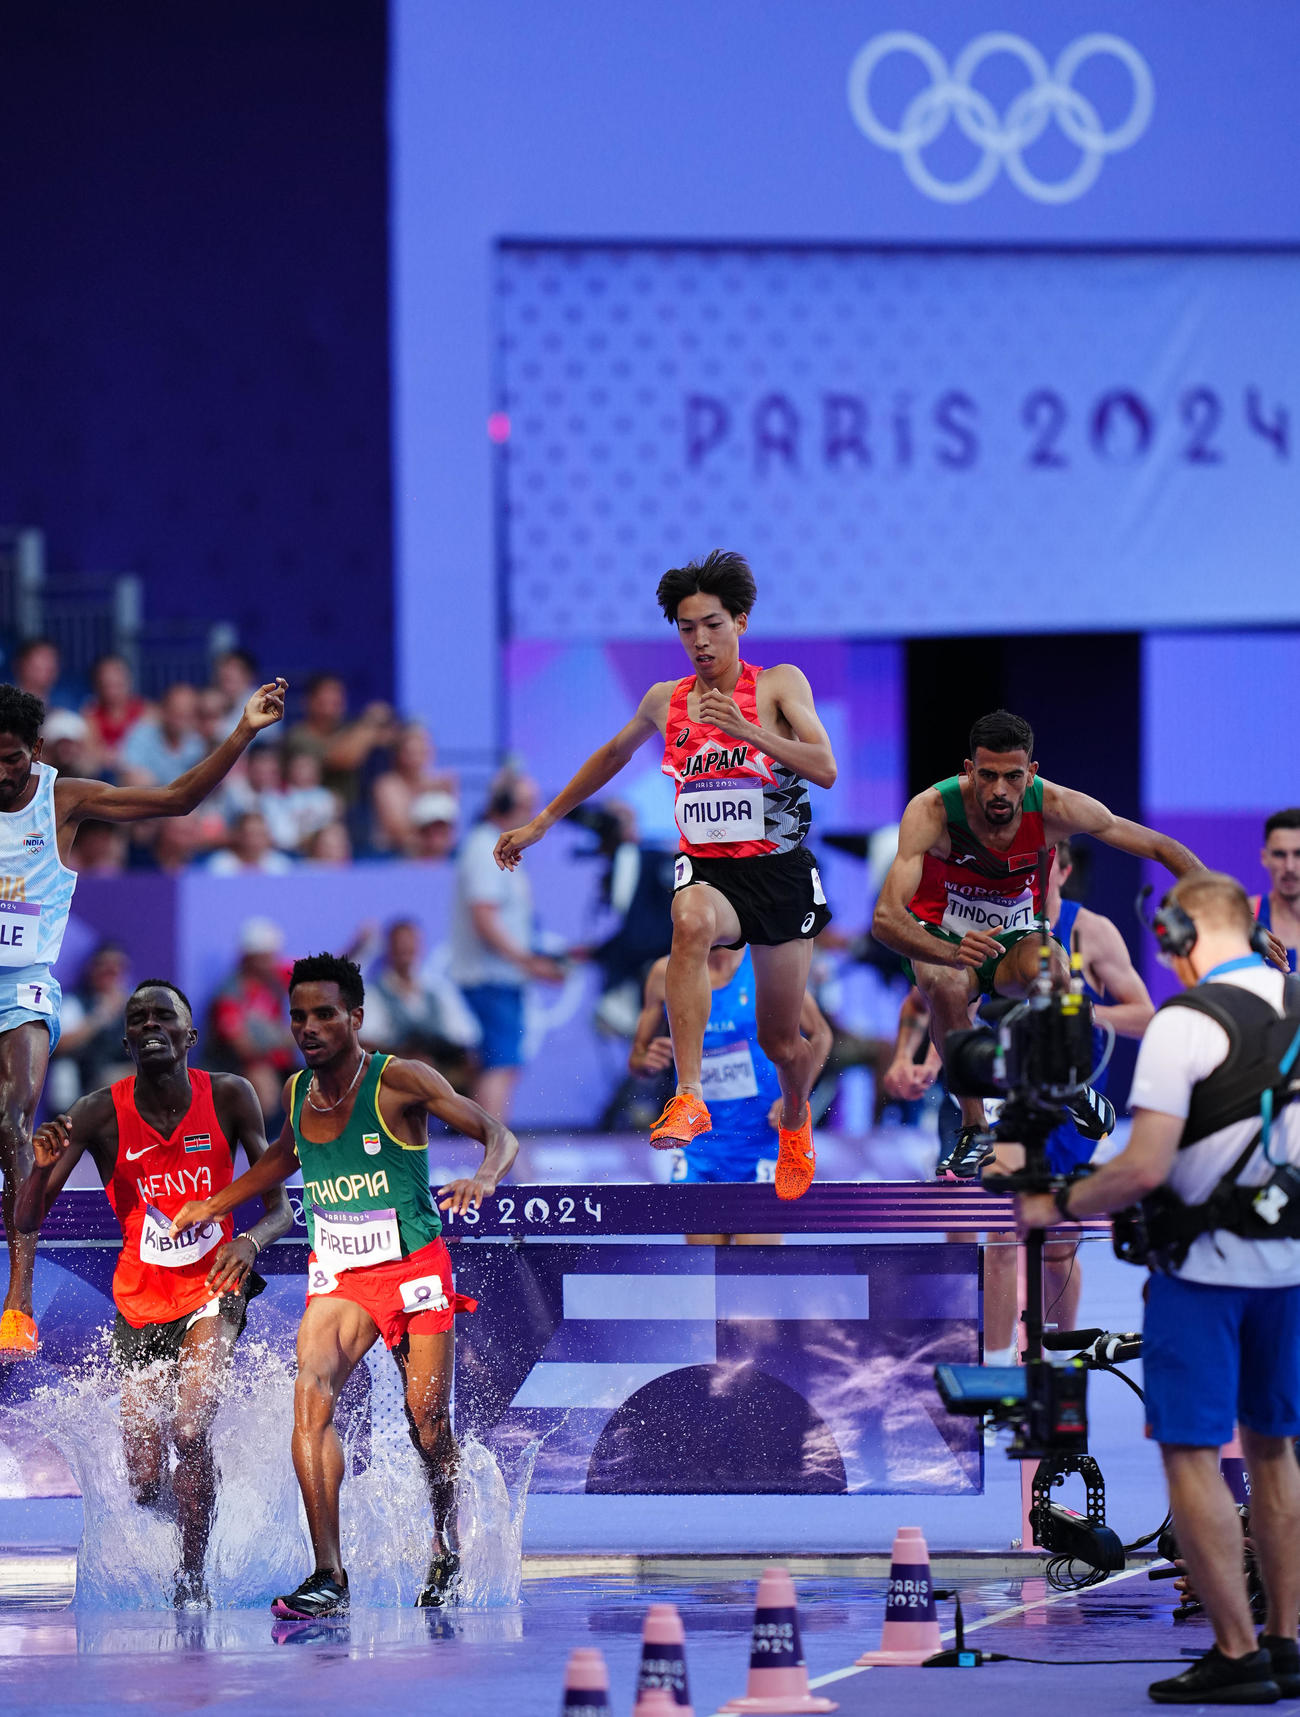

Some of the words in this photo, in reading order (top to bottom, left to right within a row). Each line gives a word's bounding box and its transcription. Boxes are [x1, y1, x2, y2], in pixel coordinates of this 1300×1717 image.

[685, 388, 979, 477] PARIS
[1022, 384, 1290, 471] 2024
[680, 746, 748, 778] JAPAN
[684, 800, 752, 823] MIURA
[0, 876, 26, 902] IA
[949, 899, 1031, 929] TINDOUFT
[29, 984, 42, 1004] 7
[137, 1166, 211, 1203] KENYA
[304, 1170, 390, 1205] THIOPIA
[498, 1197, 602, 1224] 2024
[320, 1227, 391, 1255] FIREWU
[313, 1270, 329, 1288] 8
[887, 1580, 928, 1593] PARIS
[887, 1594, 928, 1608] 2024
